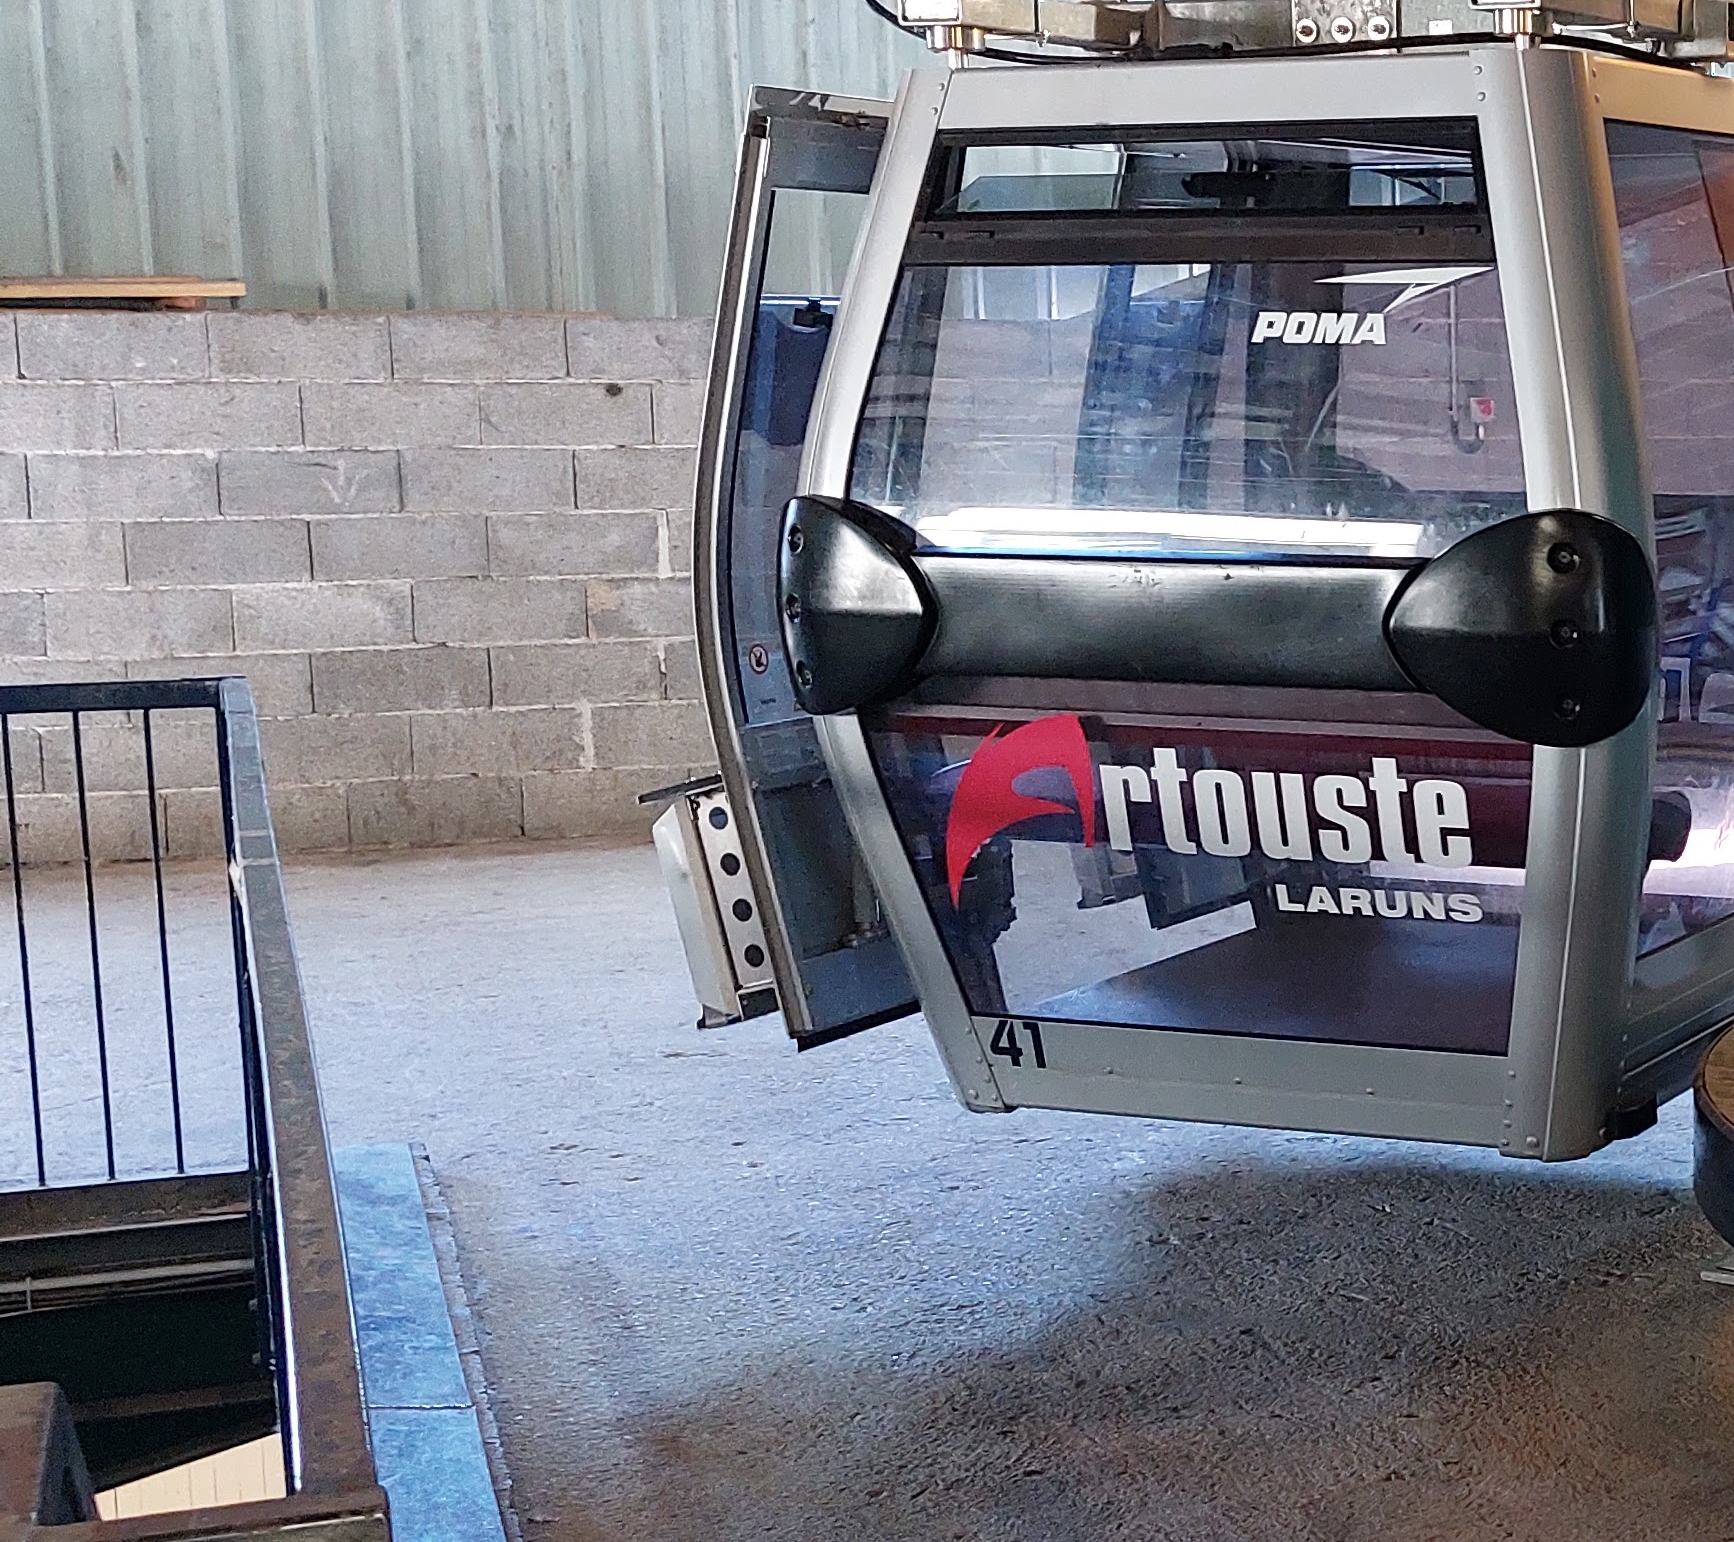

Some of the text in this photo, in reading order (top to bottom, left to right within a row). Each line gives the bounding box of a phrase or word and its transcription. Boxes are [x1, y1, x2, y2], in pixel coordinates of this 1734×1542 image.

[1251, 311, 1387, 345] POMA
[1274, 883, 1484, 923] LARUNS
[989, 1019, 1047, 1069] 41
